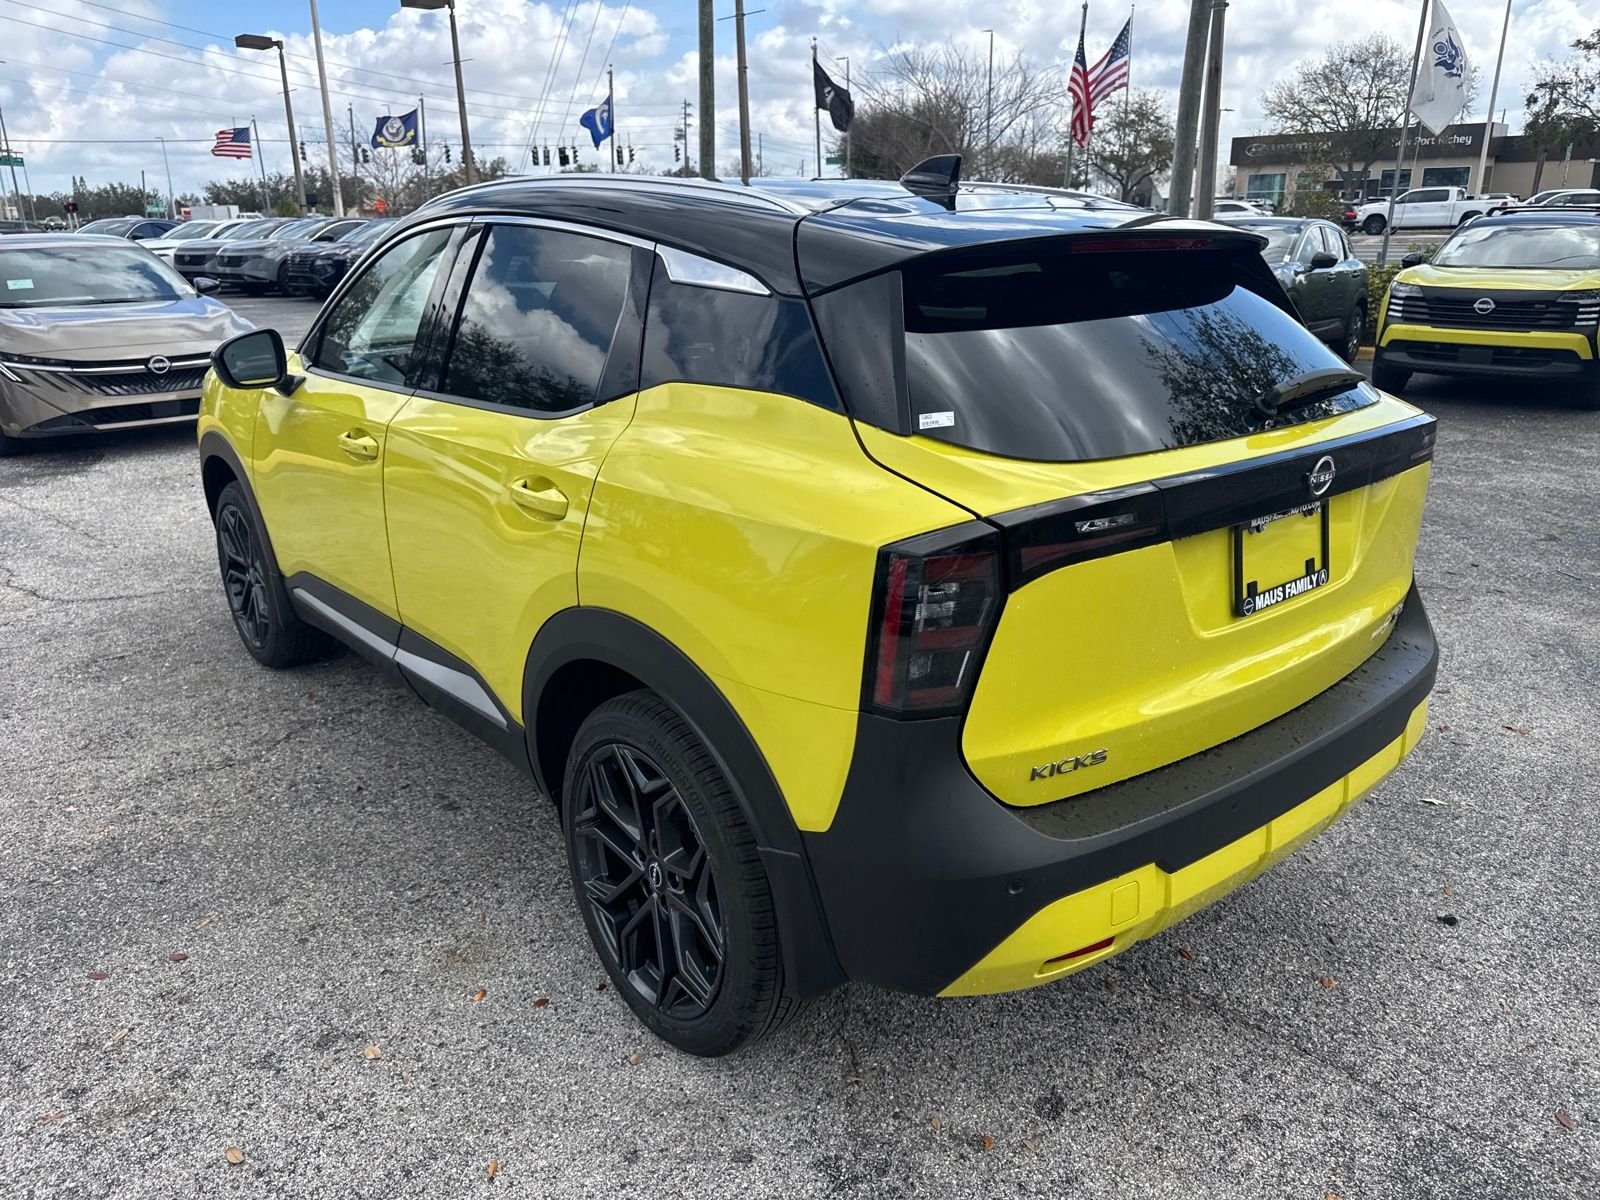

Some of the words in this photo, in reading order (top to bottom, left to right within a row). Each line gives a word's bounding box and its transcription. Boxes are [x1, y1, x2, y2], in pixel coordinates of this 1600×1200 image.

[1255, 586, 1283, 611] MAUS
[1285, 573, 1319, 599] FAMILY
[1030, 748, 1108, 781] KICKS
